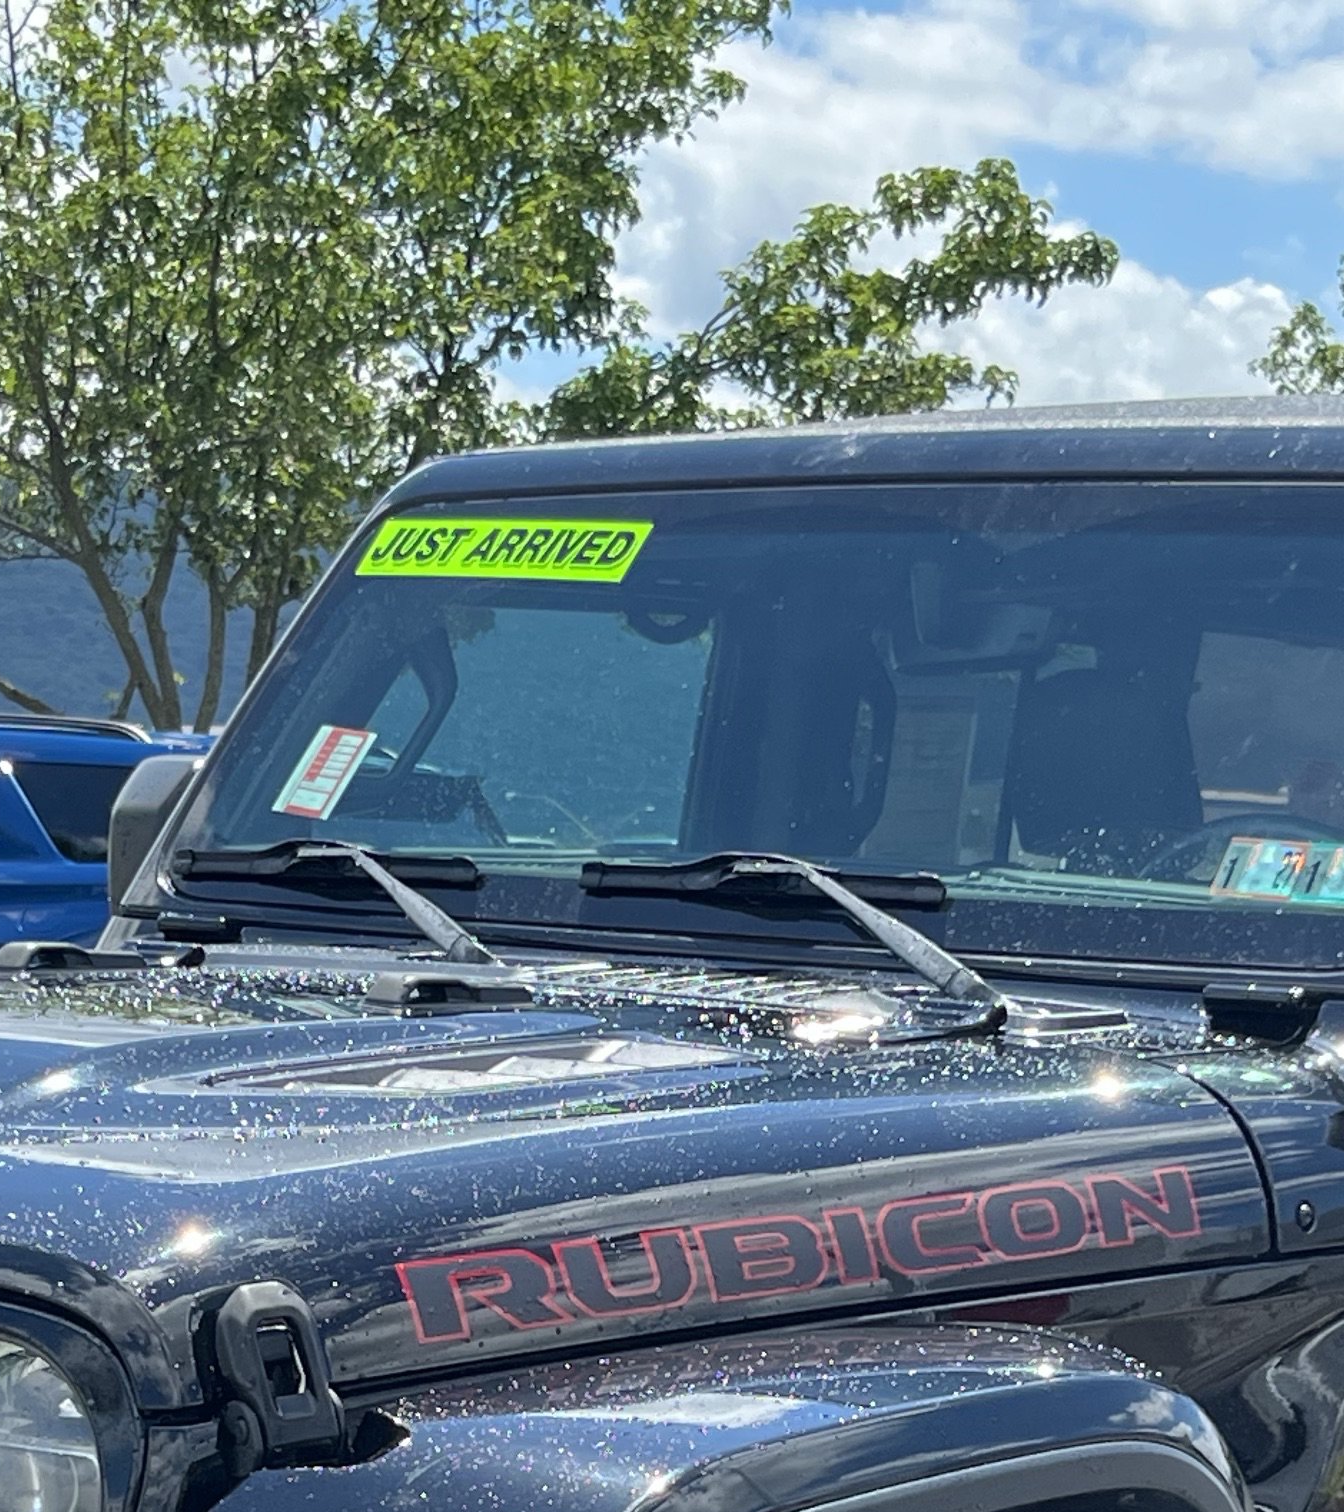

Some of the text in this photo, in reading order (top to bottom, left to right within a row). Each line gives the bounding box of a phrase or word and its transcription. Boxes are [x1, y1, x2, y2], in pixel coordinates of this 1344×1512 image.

[370, 527, 638, 568] JUST ARRIVED
[395, 1164, 1202, 1344] RUBICON
